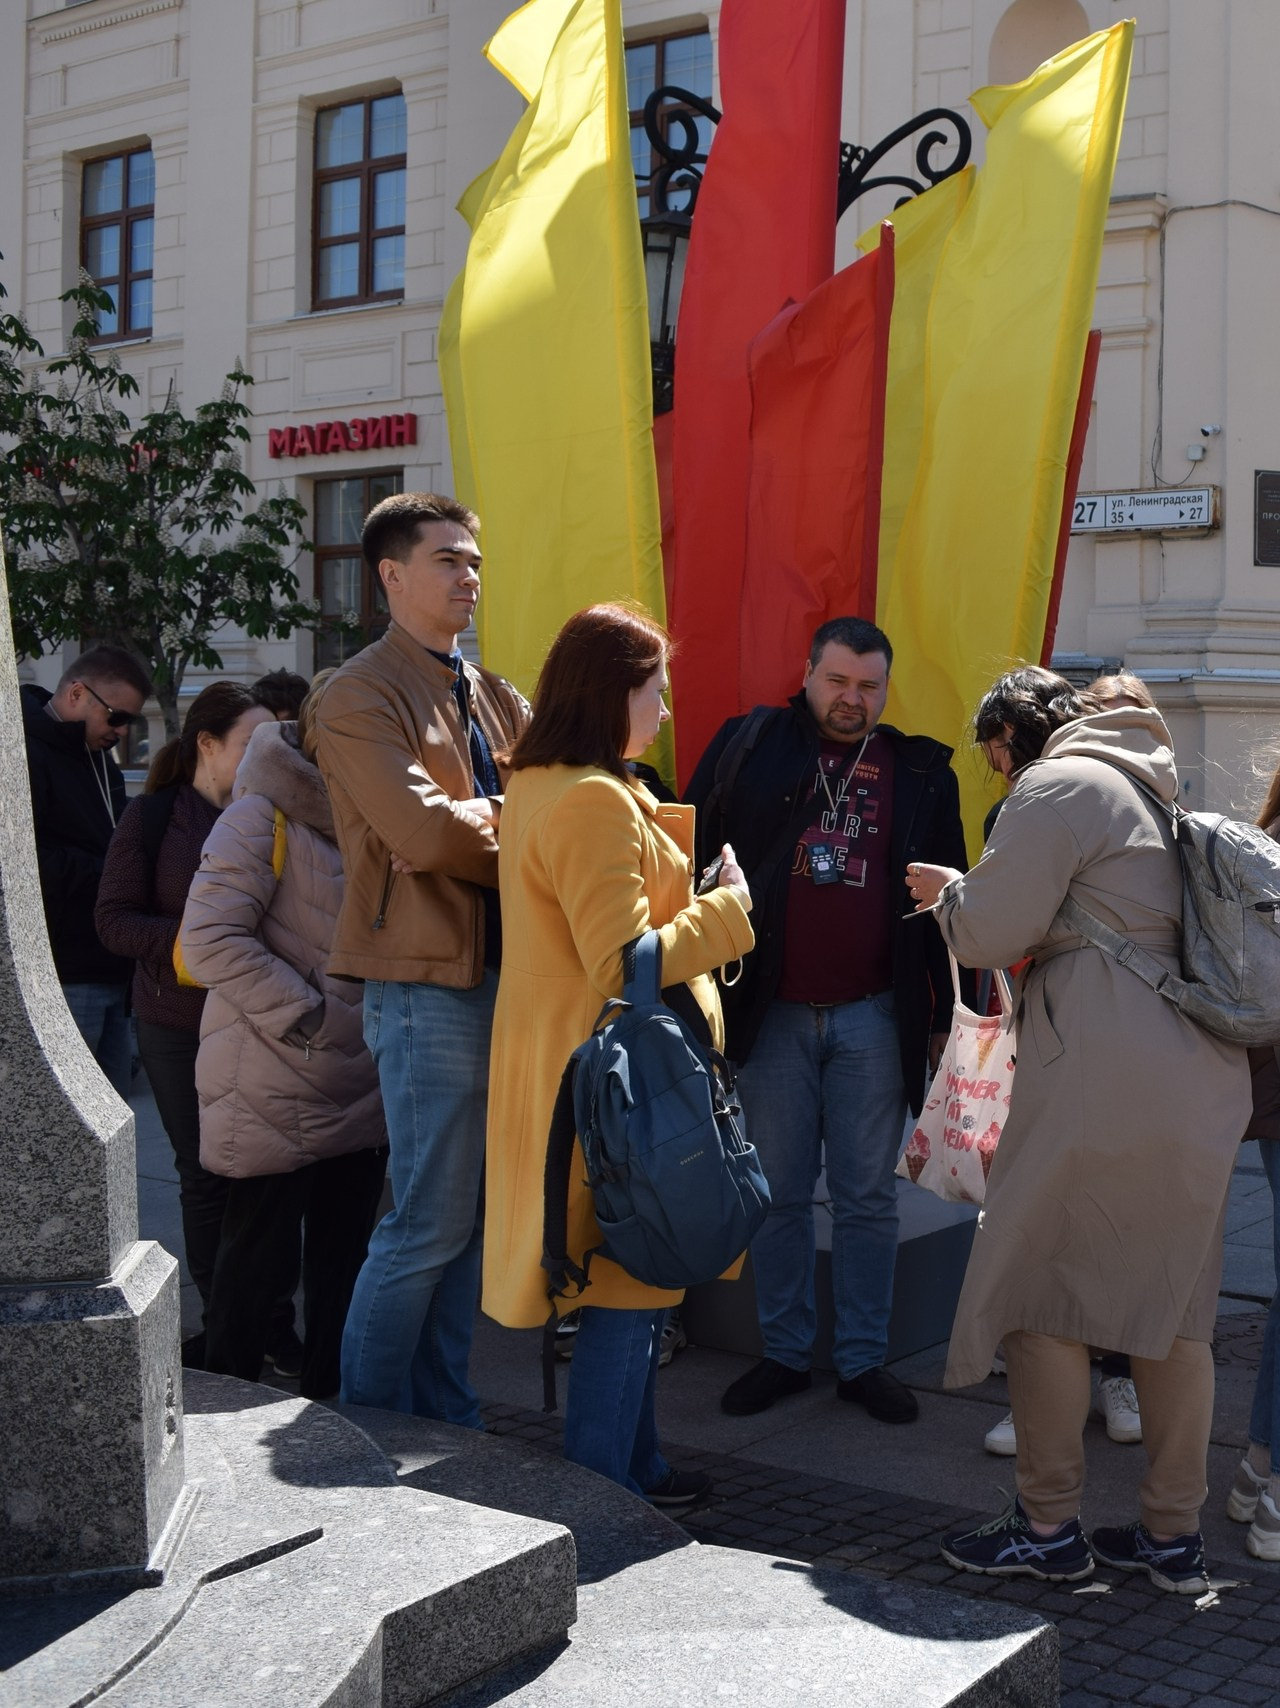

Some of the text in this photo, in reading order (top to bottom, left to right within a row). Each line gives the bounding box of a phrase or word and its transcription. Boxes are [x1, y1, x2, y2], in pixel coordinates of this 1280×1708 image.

[269, 413, 417, 459] МАГАЗИН
[1112, 495, 1203, 510] ул. Ленинградская
[1074, 501, 1097, 524] 27
[1111, 512, 1124, 524] 35
[1190, 508, 1203, 520] 27
